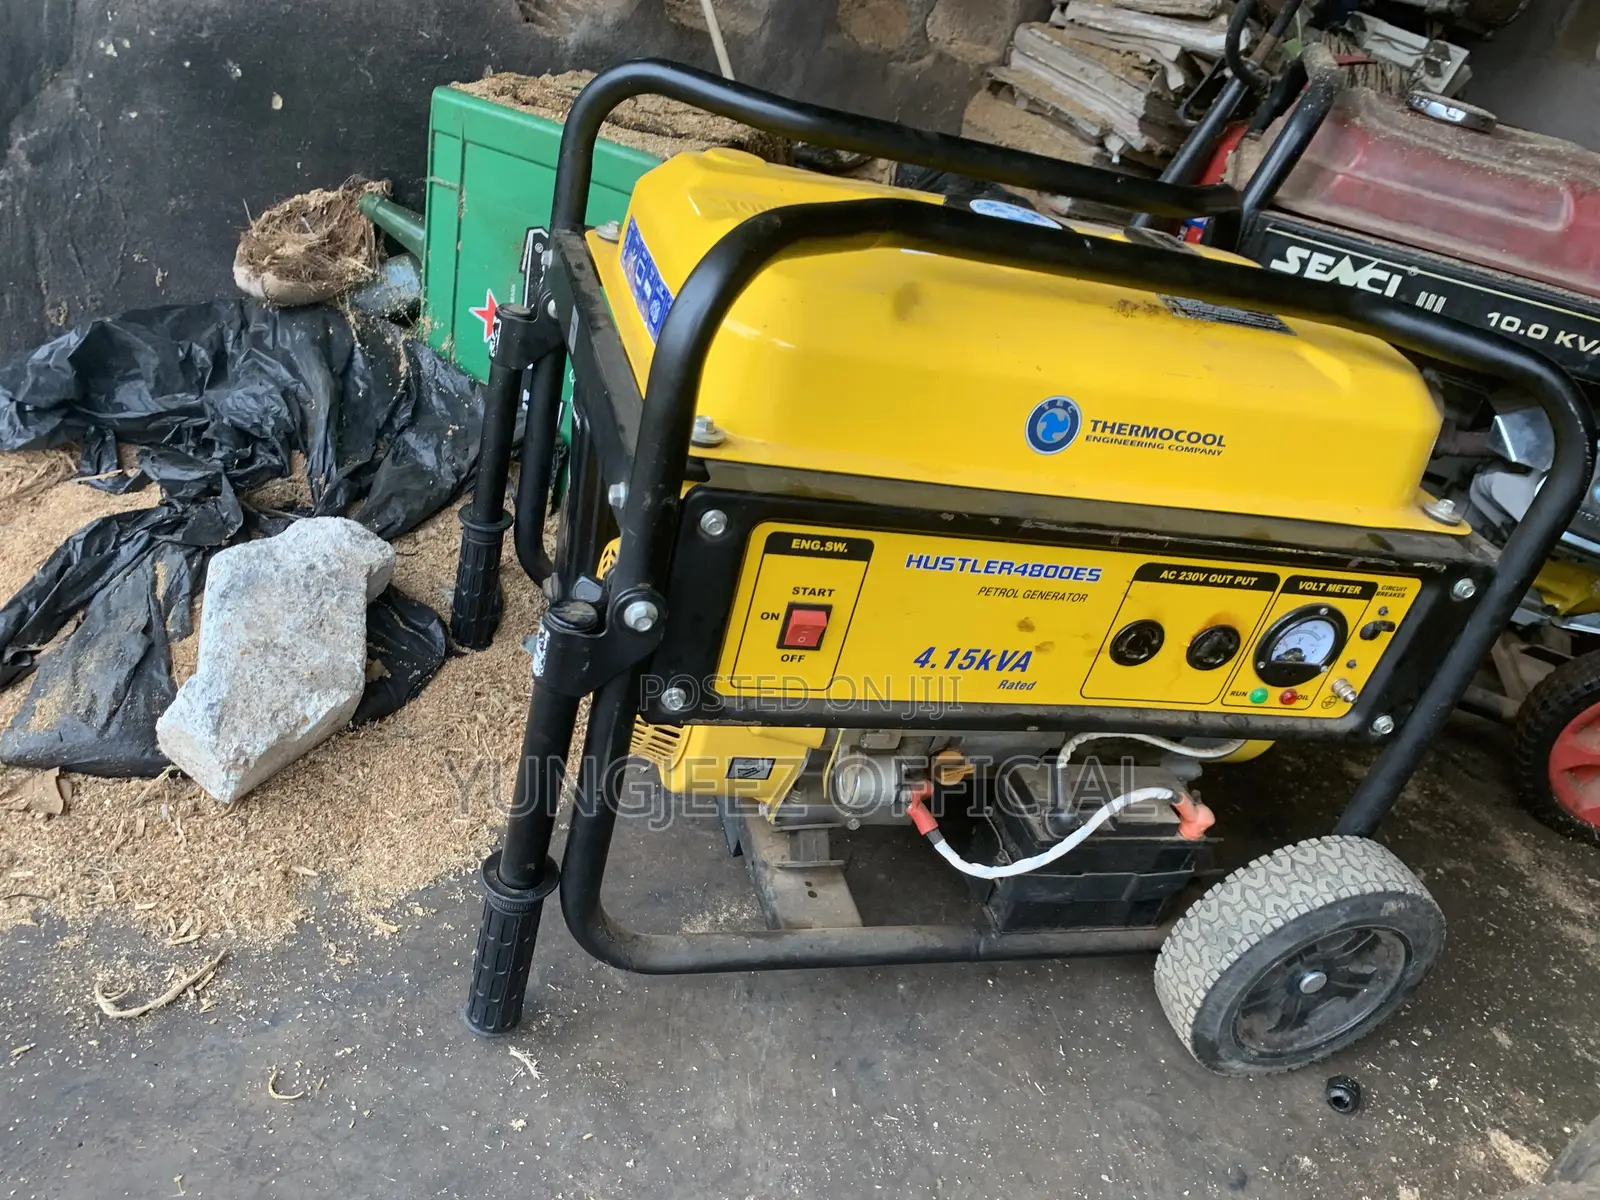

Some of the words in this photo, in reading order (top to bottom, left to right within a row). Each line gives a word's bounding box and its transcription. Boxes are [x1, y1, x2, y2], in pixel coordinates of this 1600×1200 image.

[1270, 245, 1403, 298] SENCI
[1486, 311, 1549, 340] 10.0
[1090, 419, 1226, 447] THERMOCOOL
[1085, 435, 1164, 450] ENGINEERING
[1168, 444, 1224, 457] COMPANY
[790, 538, 849, 553] ENG.SW.
[904, 553, 1103, 583] HUSTLER4800ES
[1159, 570, 1177, 580] AC
[1178, 571, 1208, 583] 230V
[1208, 573, 1234, 585] OUT
[1235, 575, 1258, 587] PUT
[791, 586, 836, 598] START
[977, 586, 1019, 599] PETROL
[1022, 588, 1089, 603] GENERATOR
[1298, 581, 1326, 592] VOLT
[1326, 582, 1362, 595] METER
[760, 611, 780, 622] ON
[780, 654, 806, 664] OFF
[913, 646, 1033, 673] 4.15kVA
[997, 678, 1037, 692] Rated
